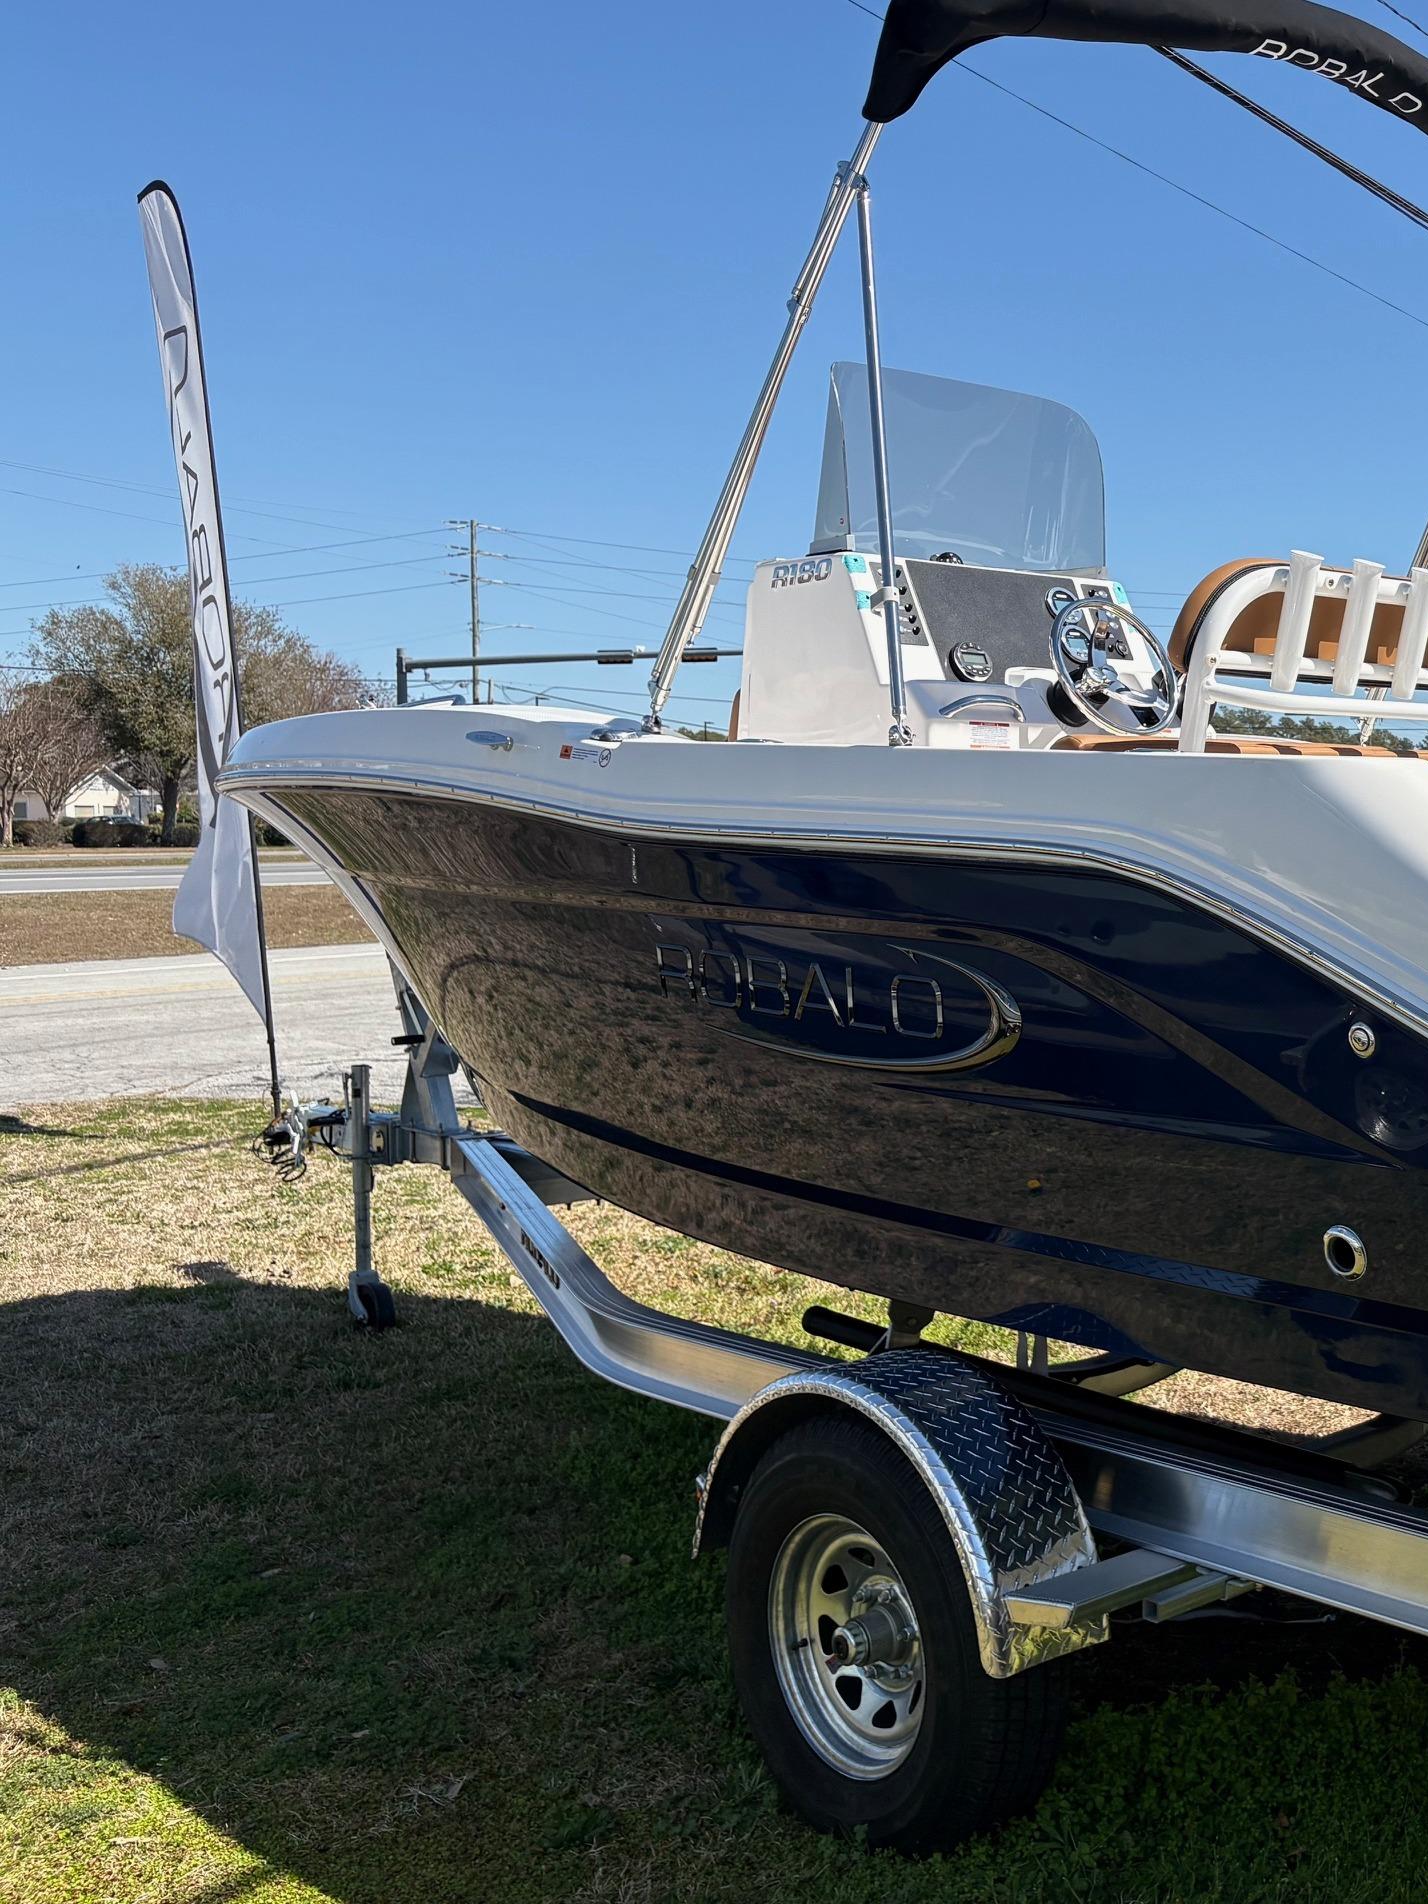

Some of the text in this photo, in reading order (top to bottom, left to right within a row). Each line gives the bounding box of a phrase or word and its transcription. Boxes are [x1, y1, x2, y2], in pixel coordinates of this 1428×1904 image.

[1249, 38, 1423, 113] ROBALO
[771, 558, 832, 588] R180
[656, 943, 945, 1039] ROBALO
